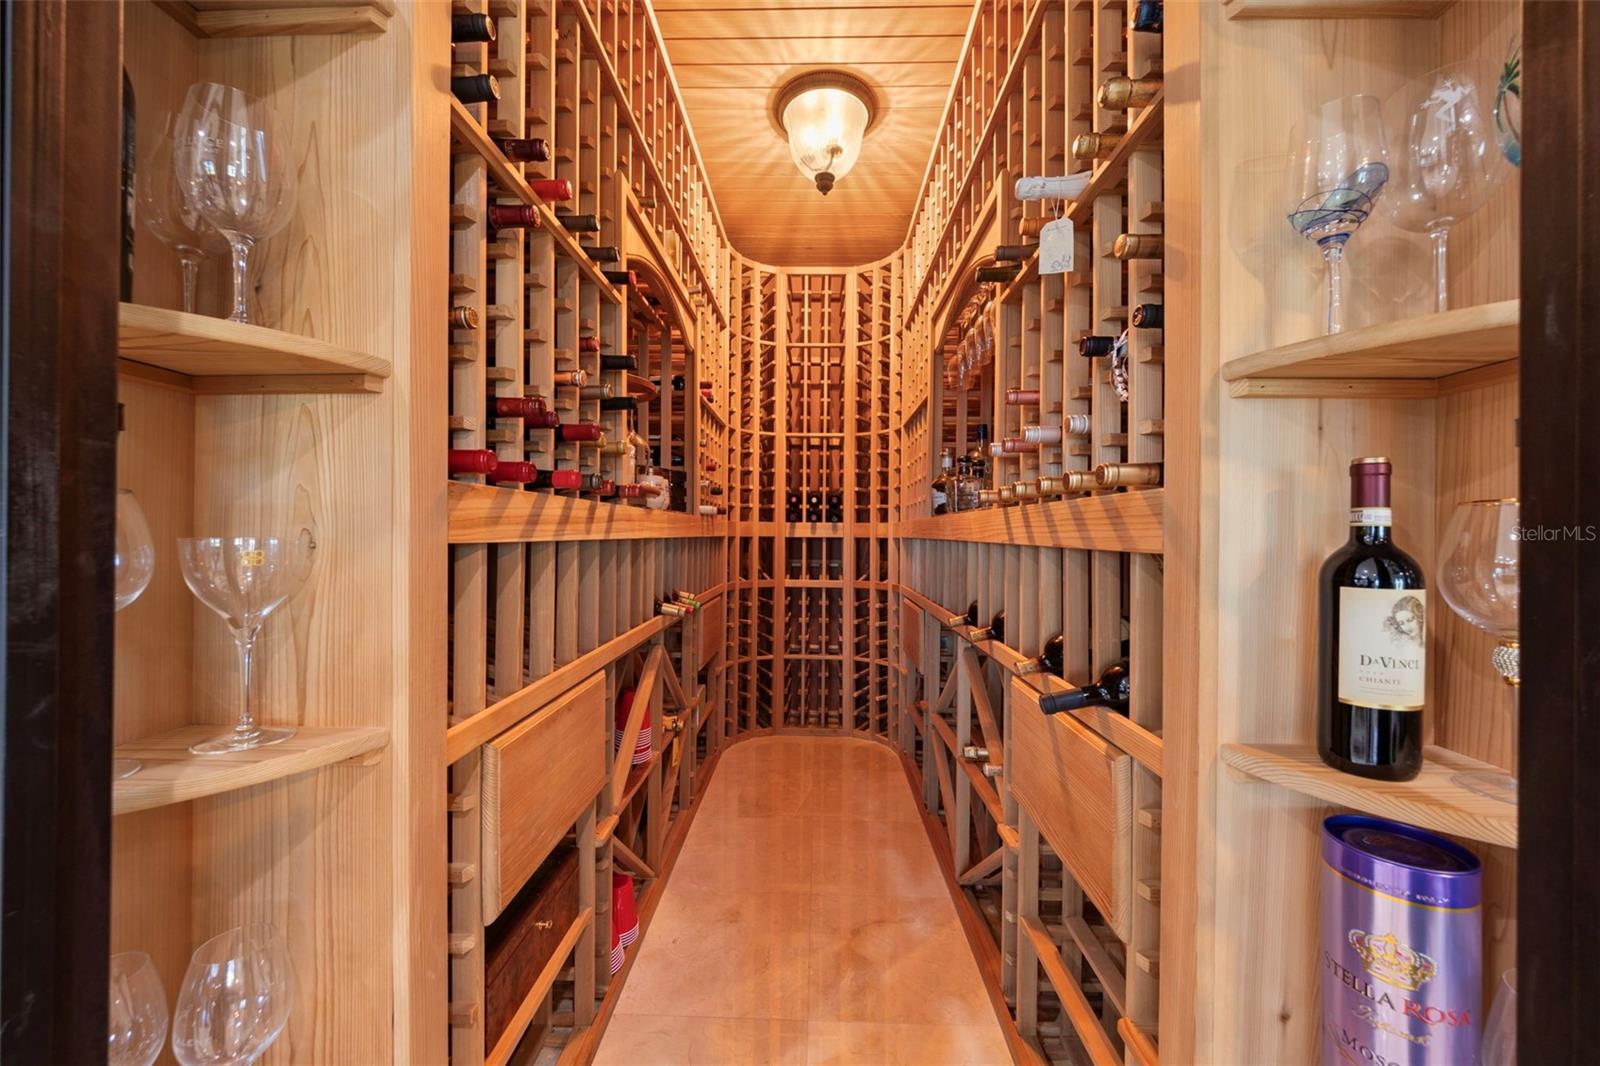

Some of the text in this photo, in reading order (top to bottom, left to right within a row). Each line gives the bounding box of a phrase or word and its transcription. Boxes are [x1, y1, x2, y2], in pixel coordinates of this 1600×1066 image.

[1359, 676, 1401, 686] CHIANTI
[1324, 951, 1396, 1012] STELLA
[1403, 998, 1472, 1026] ROSA
